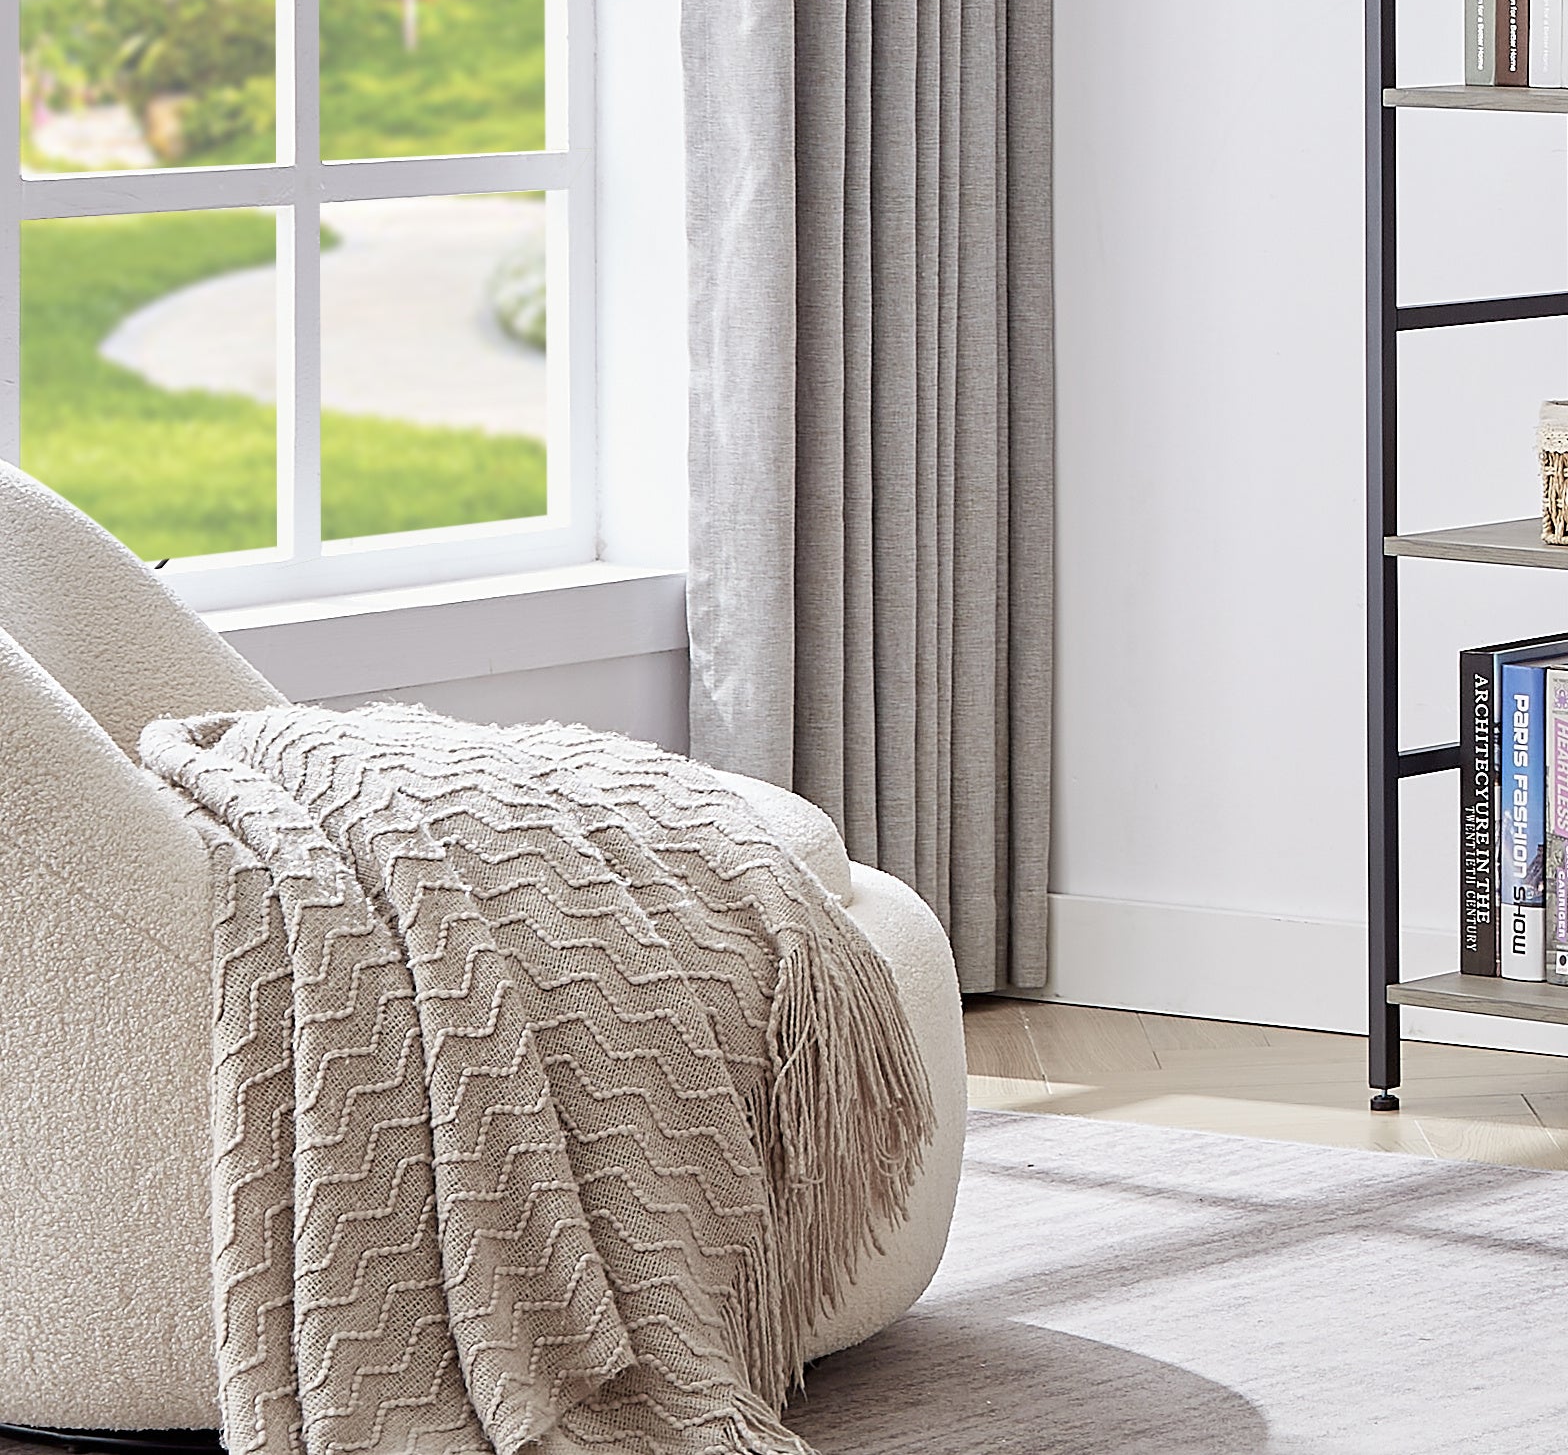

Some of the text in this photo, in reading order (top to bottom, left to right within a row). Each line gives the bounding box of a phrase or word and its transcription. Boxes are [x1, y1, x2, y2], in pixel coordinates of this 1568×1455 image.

[1476, 5, 1484, 16] for
[1509, 6, 1517, 17] for
[1476, 23, 1484, 46] Better
[1509, 24, 1517, 48] Better
[1476, 47, 1484, 70] Home
[1509, 48, 1517, 72] Home
[1474, 673, 1490, 924] ARCHITECYURE IN THE
[1558, 871, 1566, 938] CARRIGER
[1465, 890, 1477, 952] CENTURY
[1513, 886, 1526, 954] SHOW
